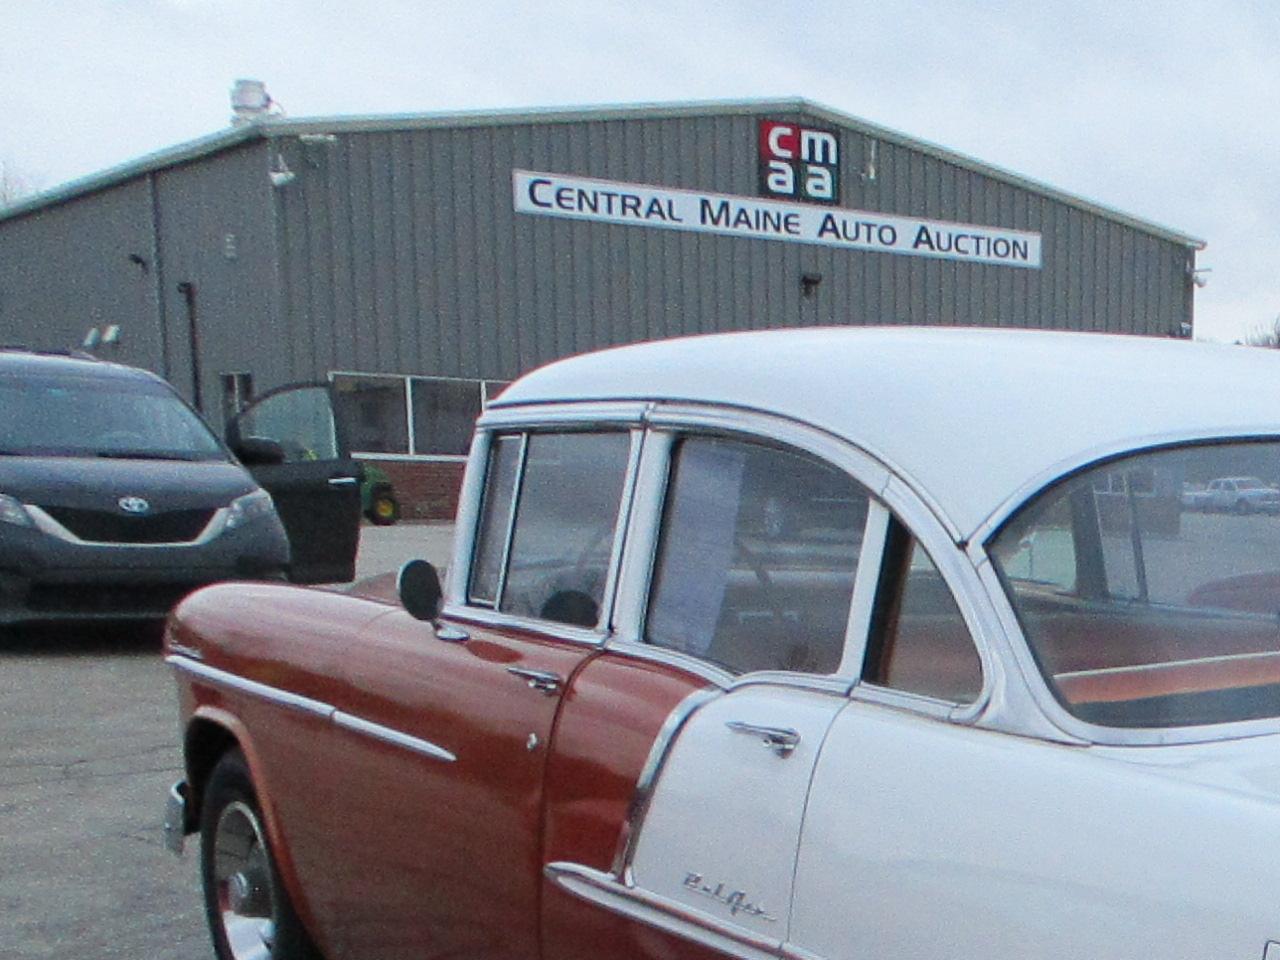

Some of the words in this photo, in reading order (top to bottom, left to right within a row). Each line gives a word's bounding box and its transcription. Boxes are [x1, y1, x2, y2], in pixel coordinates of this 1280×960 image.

[528, 178, 684, 223] CENTRAL
[700, 197, 801, 235] MAINE
[817, 213, 897, 247] AUTO
[912, 225, 1029, 261] AUCTION
